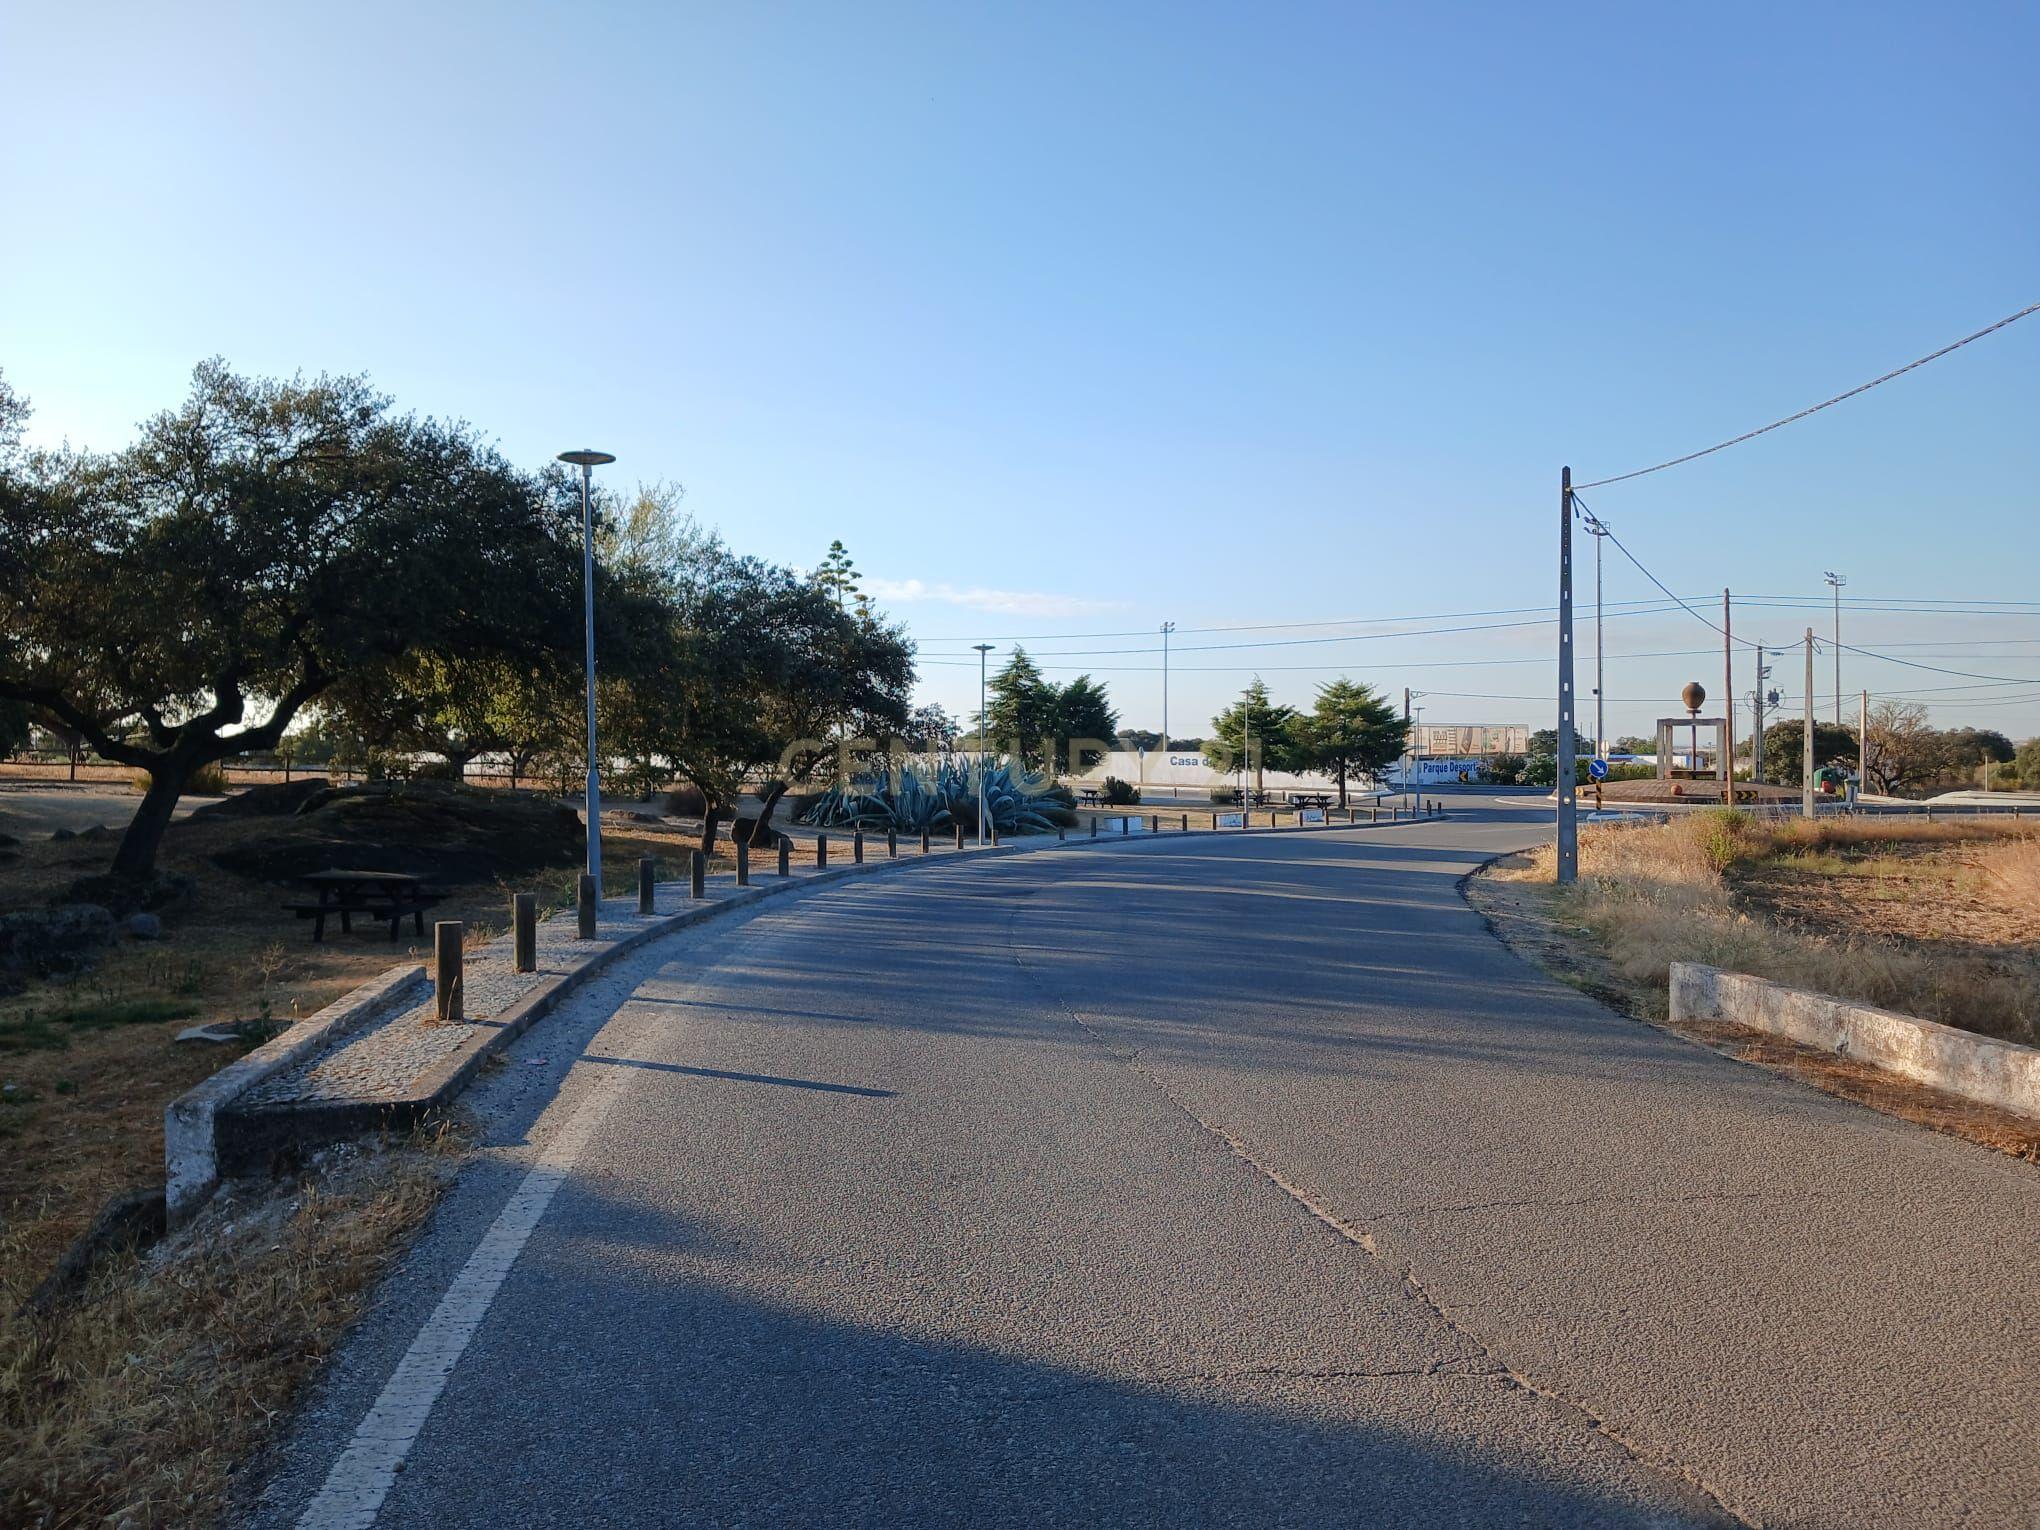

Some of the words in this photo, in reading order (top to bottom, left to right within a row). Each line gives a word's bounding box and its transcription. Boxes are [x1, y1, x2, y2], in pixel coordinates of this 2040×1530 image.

[1170, 756, 1198, 766] Casa
[1423, 762, 1448, 775] Parque
[1450, 761, 1478, 772] Desport
